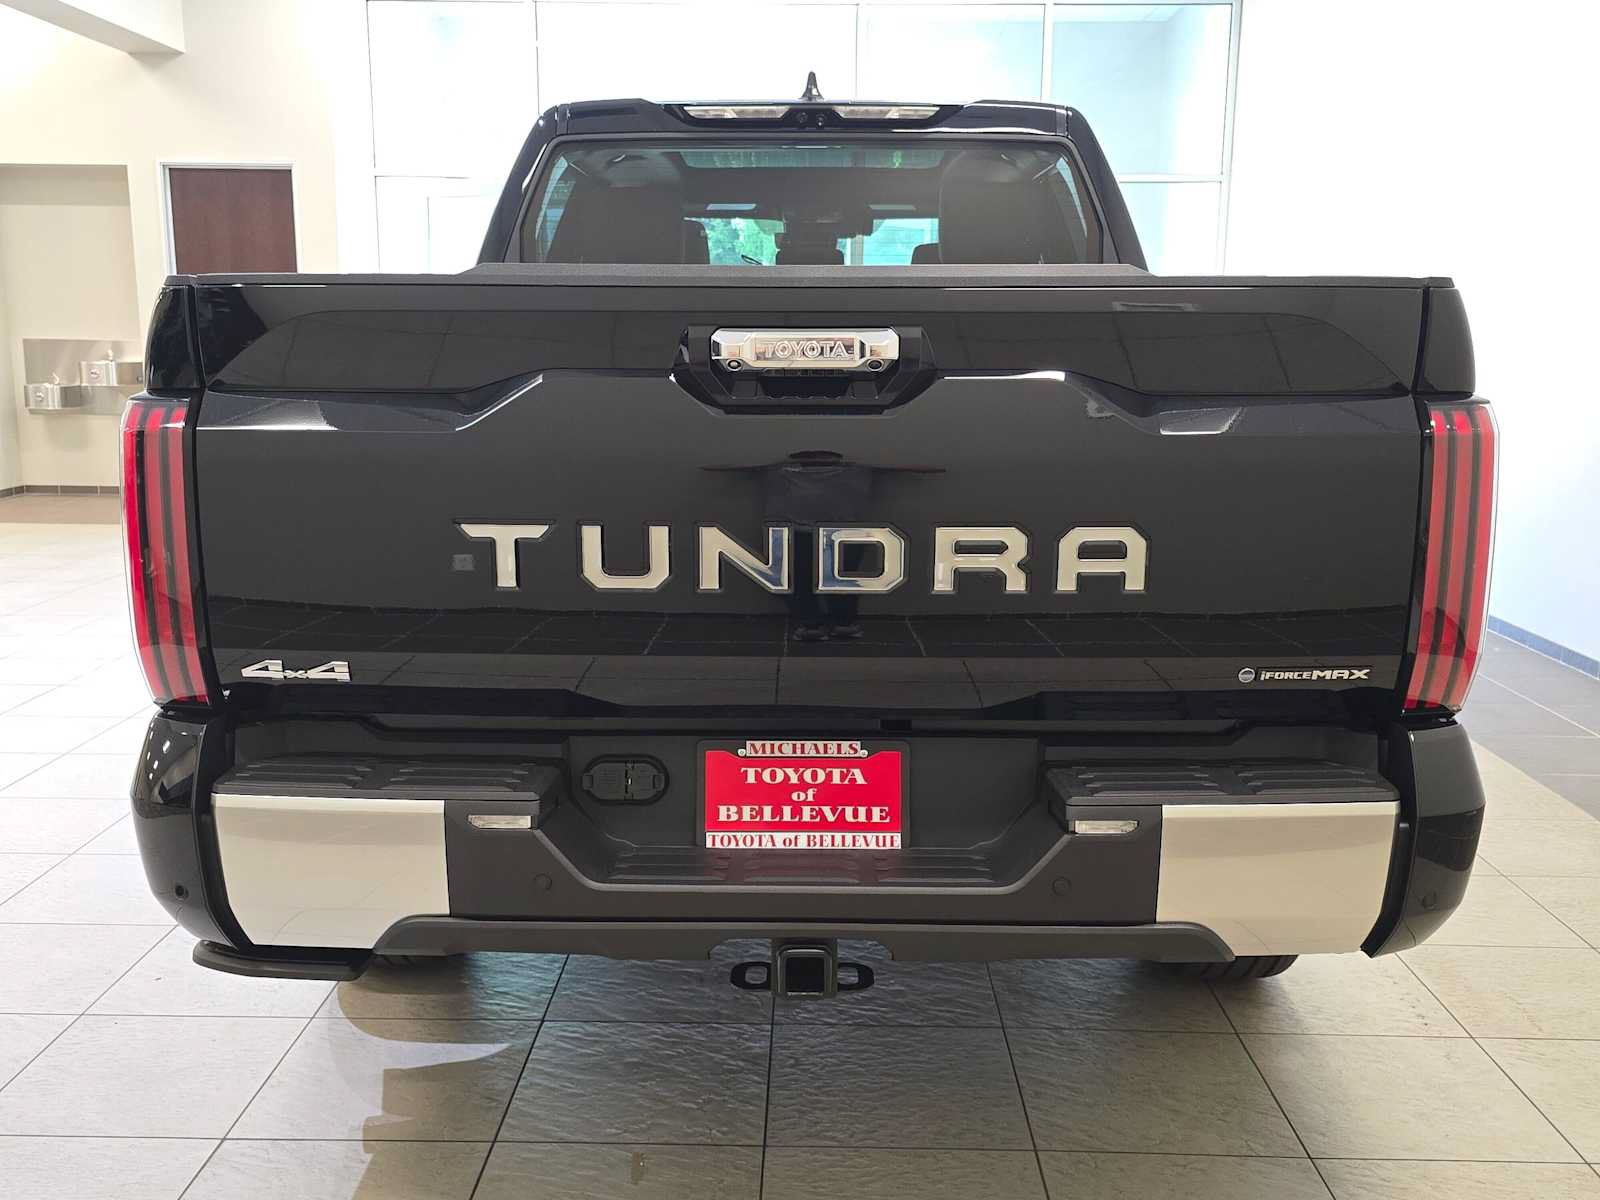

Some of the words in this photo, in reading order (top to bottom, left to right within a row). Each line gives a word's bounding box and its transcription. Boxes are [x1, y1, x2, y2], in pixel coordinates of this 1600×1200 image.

[765, 340, 848, 360] TOYOTA
[456, 523, 1148, 593] TUNDRA
[241, 660, 351, 682] 4x4
[749, 742, 859, 756] MICHAELS
[741, 767, 868, 785] TOYOTA
[791, 788, 817, 802] of
[717, 805, 891, 823] BELLEVUE
[708, 834, 777, 848] TOYOTA
[783, 834, 800, 848] of
[807, 834, 899, 849] BELLEVUE
